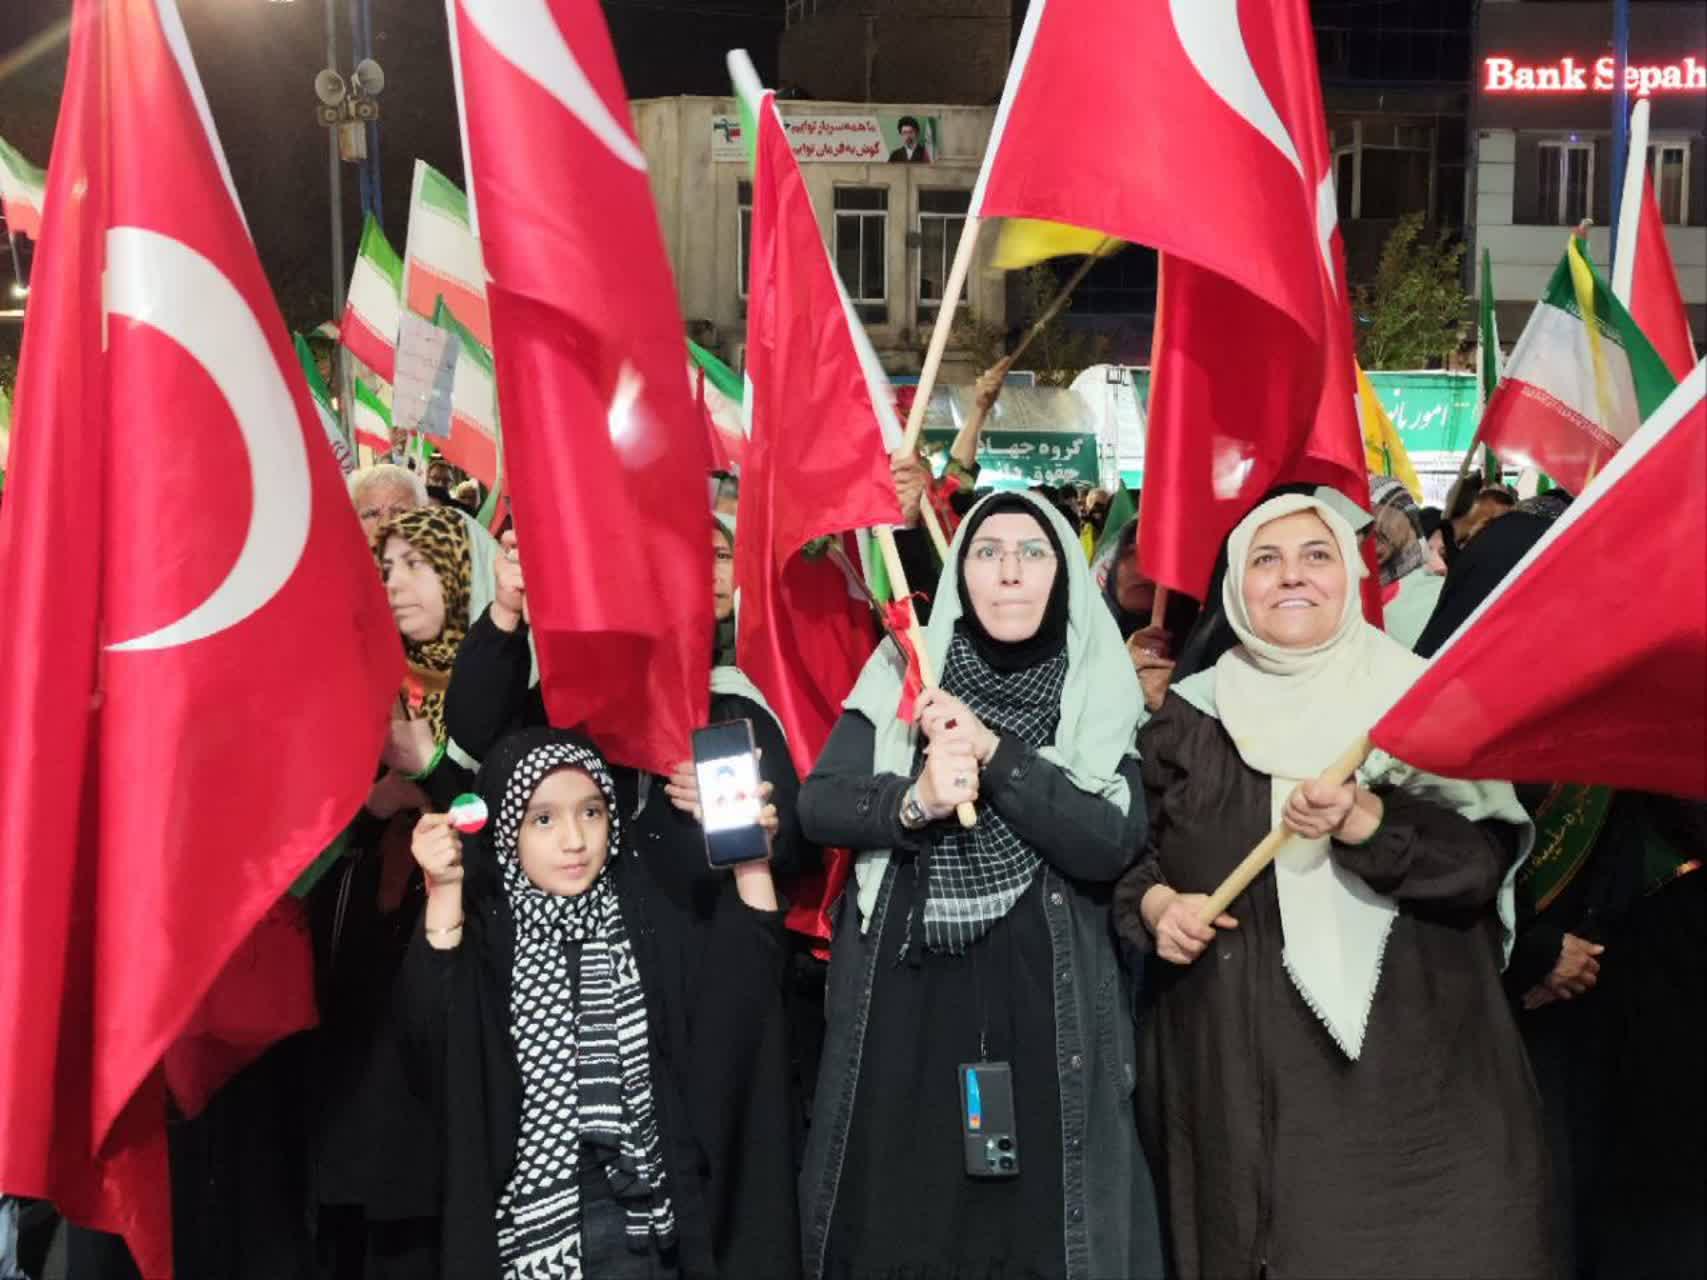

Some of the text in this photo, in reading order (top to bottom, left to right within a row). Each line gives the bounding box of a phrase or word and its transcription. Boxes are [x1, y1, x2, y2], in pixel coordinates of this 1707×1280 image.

[1485, 56, 1707, 95] Bank Sepah
[1407, 403, 1449, 431] امور
[1039, 438, 1084, 461] گروه
